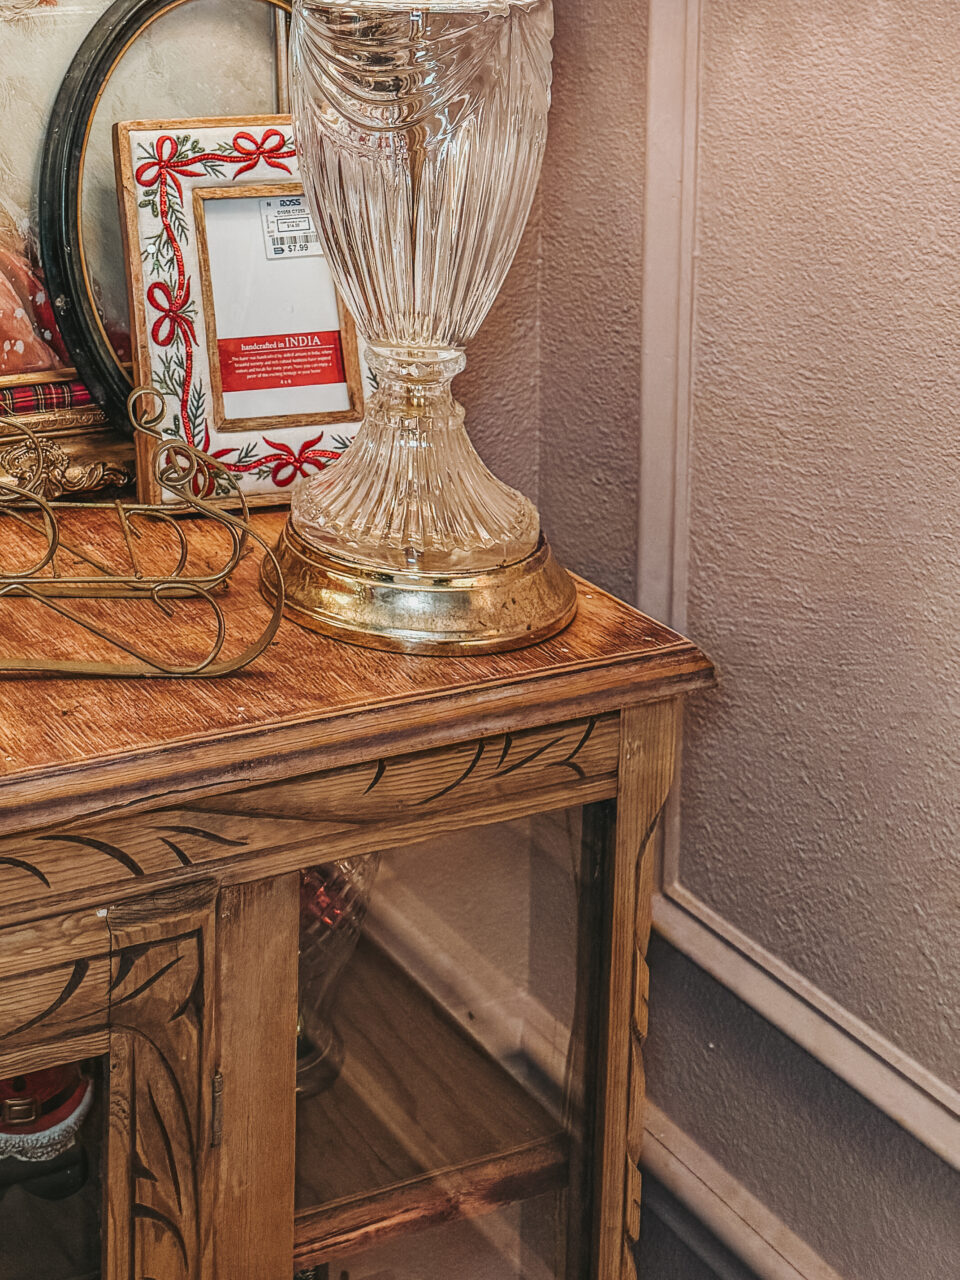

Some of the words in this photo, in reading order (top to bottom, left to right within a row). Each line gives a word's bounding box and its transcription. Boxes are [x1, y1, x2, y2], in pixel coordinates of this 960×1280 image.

[280, 198, 301, 207] ROSS
[288, 243, 309, 252] $7.99
[241, 341, 277, 351] handcrafted
[285, 336, 321, 347] INDIA
